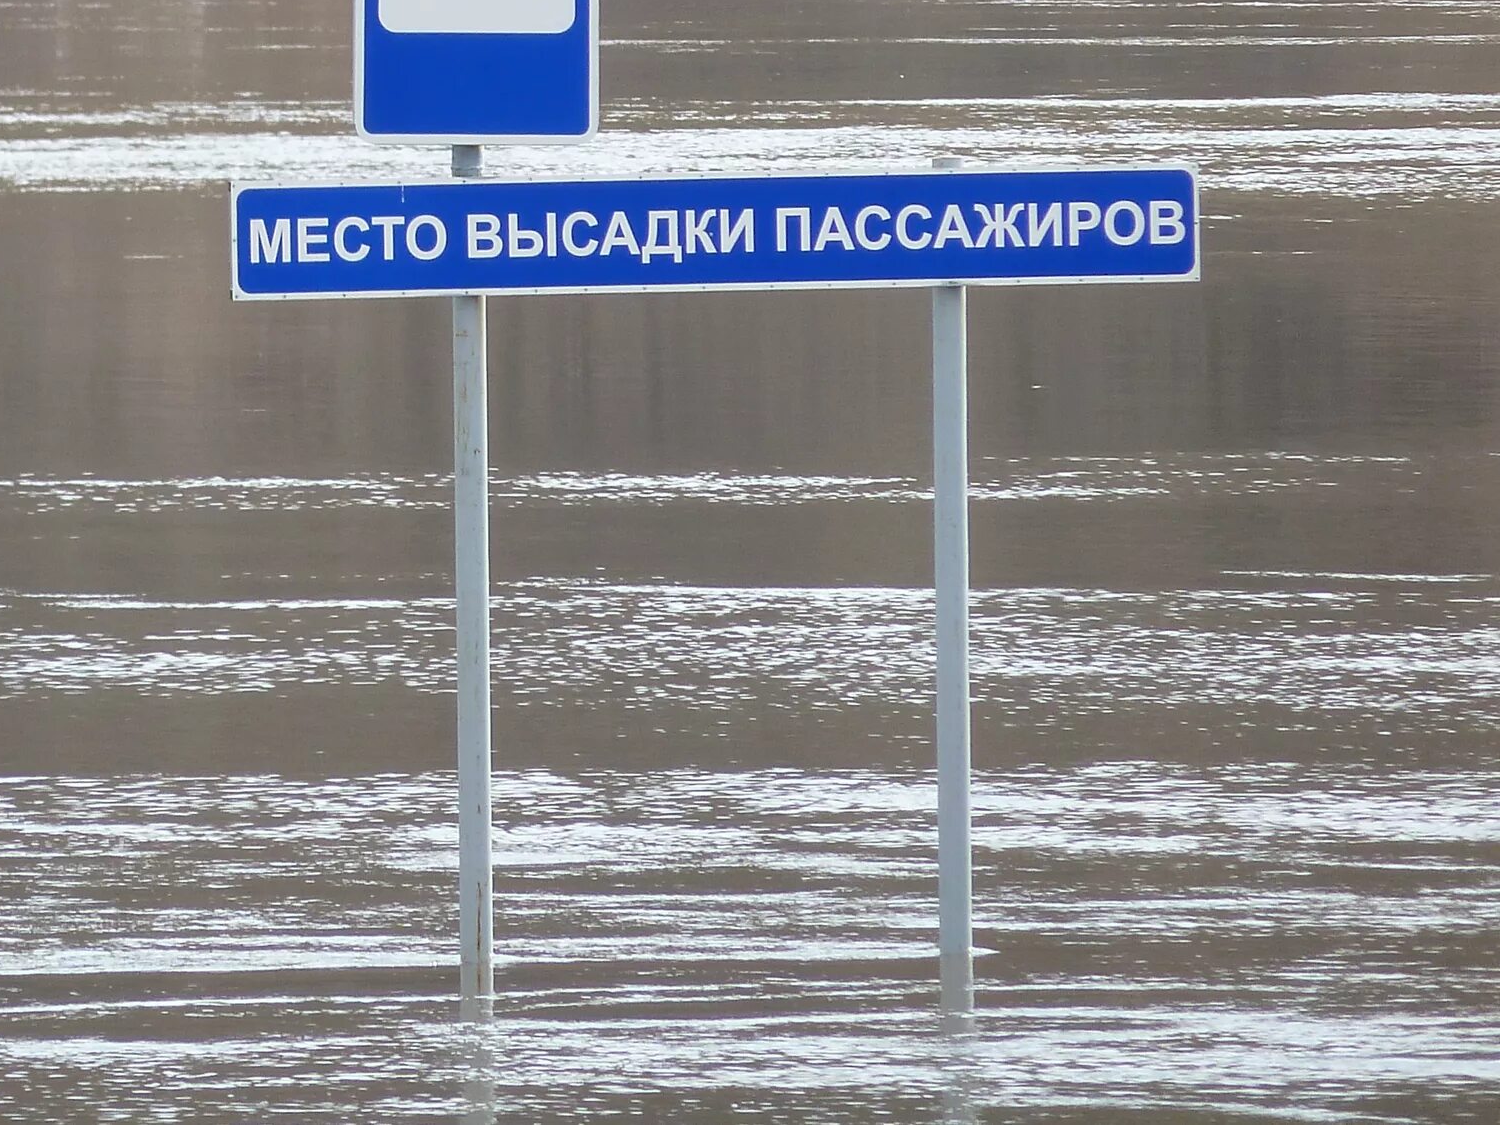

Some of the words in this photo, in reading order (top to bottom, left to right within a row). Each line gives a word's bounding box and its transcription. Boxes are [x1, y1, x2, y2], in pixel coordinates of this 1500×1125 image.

[249, 214, 447, 264] МЕСТО
[467, 208, 755, 264] ВЫСАДКИ
[775, 200, 1186, 253] ПАССАЖИРОВ
